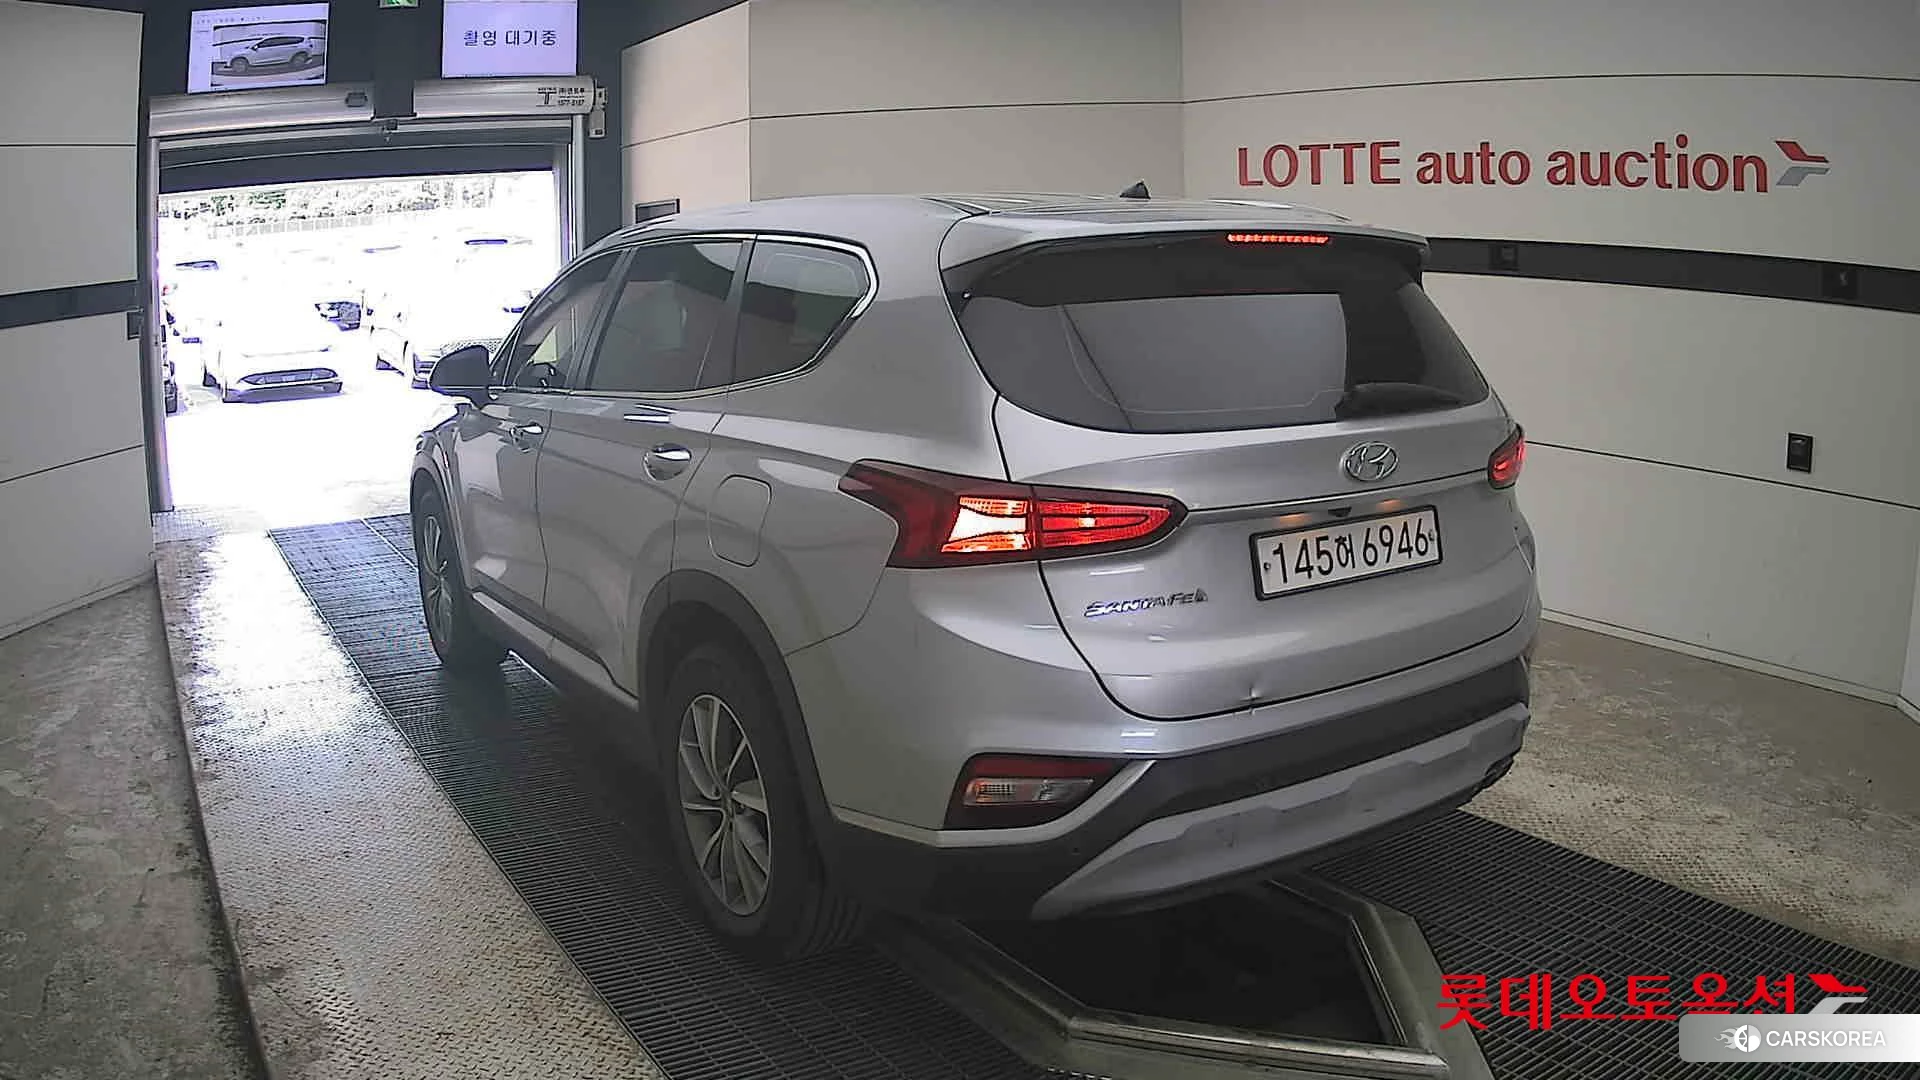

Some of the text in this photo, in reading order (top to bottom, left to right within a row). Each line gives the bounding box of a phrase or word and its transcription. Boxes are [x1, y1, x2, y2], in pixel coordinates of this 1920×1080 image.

[463, 30, 558, 47] 촬영 대기중
[1238, 134, 1768, 194] LOTTE auto auction
[1362, 518, 1430, 567] 6946
